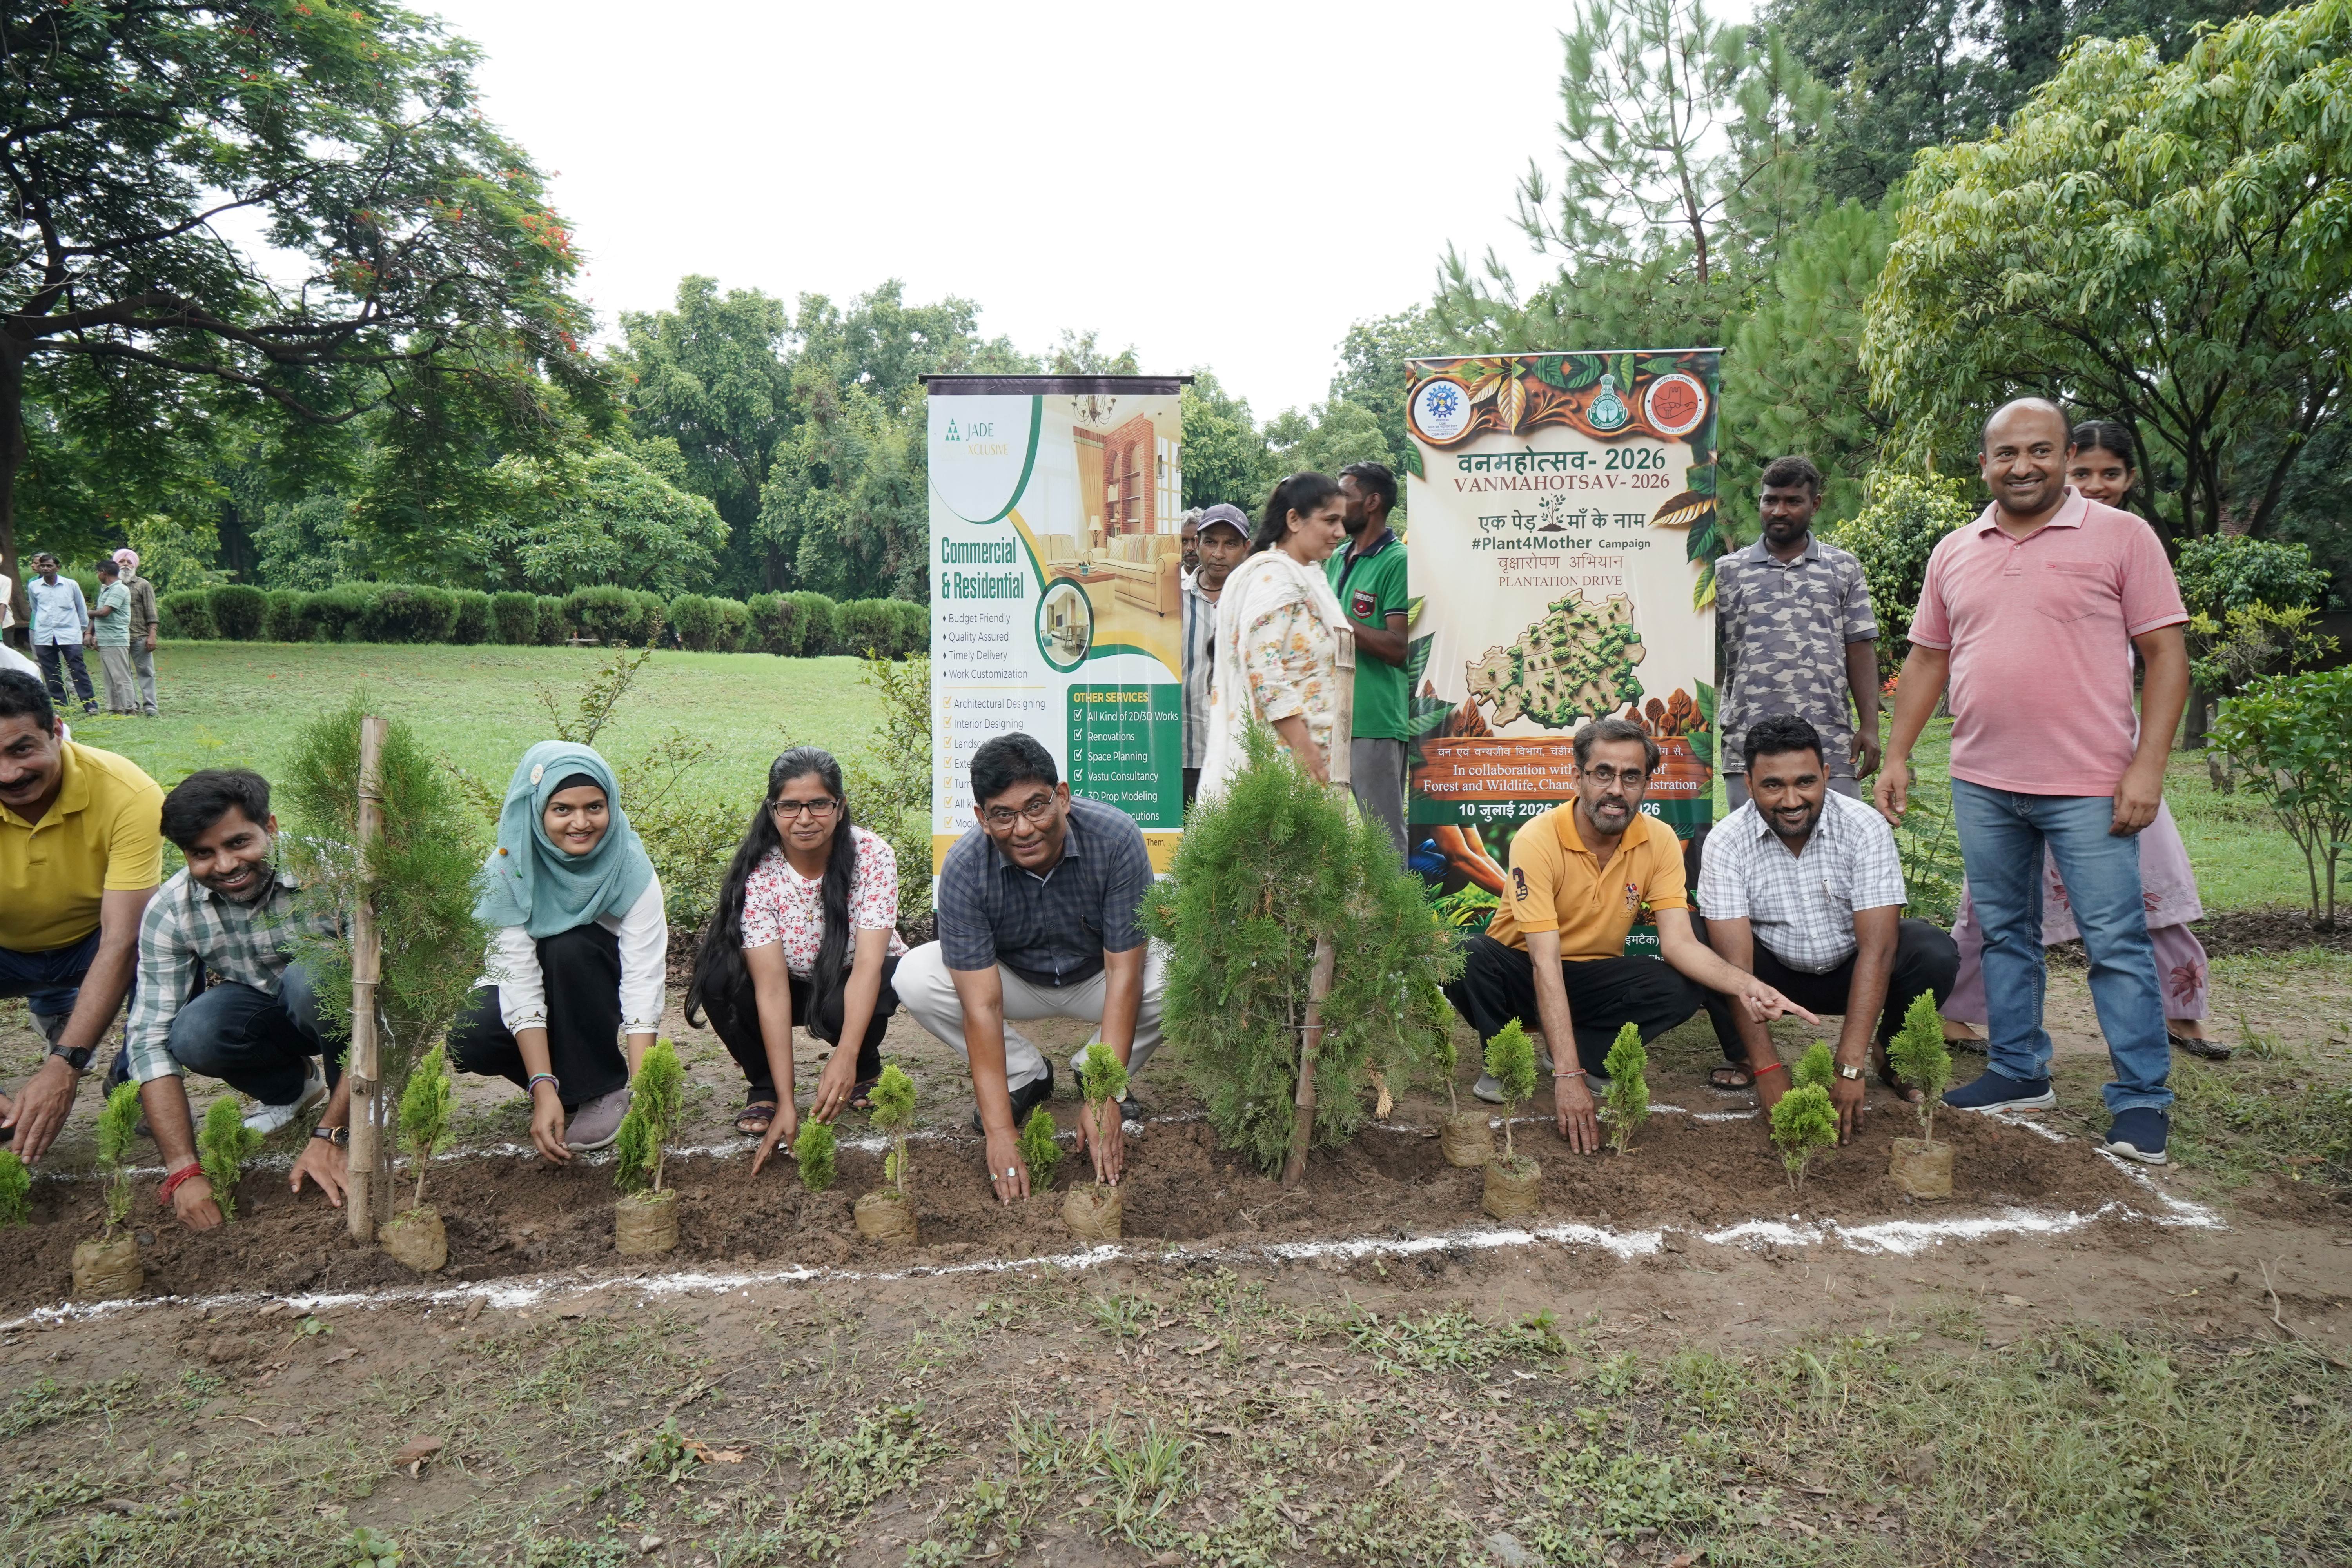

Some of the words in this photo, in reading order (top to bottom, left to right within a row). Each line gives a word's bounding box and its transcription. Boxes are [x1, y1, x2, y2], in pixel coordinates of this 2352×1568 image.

[1647, 410, 1671, 432] CHANDIGARH
[1671, 408, 1702, 433] ADMINISTRATION
[966, 423, 994, 441] JADE
[968, 444, 1009, 455] XCLUSIVE
[1604, 448, 1666, 470] 2026
[1453, 475, 1626, 493] VANMAHOTSAV-
[1631, 474, 1670, 489] 2026
[1478, 515, 1507, 533] एक
[1511, 510, 1537, 533] पेड़
[1566, 508, 1589, 529] माँ
[1591, 508, 1608, 529] के
[1613, 513, 1646, 529] नाम
[1472, 536, 1592, 550] #Plant4Mother
[1599, 539, 1651, 550] Campaign
[942, 537, 1016, 564] Commercial
[1497, 552, 1561, 574] वृक्षारोपण
[1569, 553, 1624, 570] अभियान
[942, 572, 950, 599] &
[954, 572, 1024, 599] Residential
[1499, 575, 1579, 587] PLANTATION
[1583, 575, 1622, 586] DRIVE
[1354, 592, 1374, 603] FRIENDS
[949, 613, 977, 625] Budget
[979, 613, 1011, 625] Friendly
[949, 632, 976, 644] Quality
[978, 632, 1009, 641] Assured
[949, 650, 975, 662] Timely
[977, 650, 1007, 662] Delivery
[949, 669, 969, 679] Work
[971, 669, 1028, 679] Customization
[1073, 692, 1104, 703] OTHER
[1106, 692, 1149, 702] SERVICES
[954, 699, 1004, 709] Architectural
[1007, 699, 1045, 711] Designing
[1087, 711, 1098, 721] All
[1099, 711, 1117, 721] Kind
[1119, 711, 1127, 721] of
[1128, 711, 1153, 722] 2D/3D
[1154, 711, 1178, 721] Works
[955, 719, 983, 728] Interior
[985, 719, 1024, 730] Designing
[1088, 731, 1135, 742] Renovations
[1088, 752, 1111, 763] Space
[1113, 751, 1148, 763] Planning
[1437, 748, 1452, 757] वन
[1456, 746, 1470, 758] एवं
[1474, 746, 1511, 757] वन्यजीव
[1515, 745, 1545, 757] विभाग,
[1673, 744, 1684, 757] से,
[1453, 764, 1465, 776] In
[1468, 763, 1546, 775] collaboration
[1088, 771, 1109, 781] Vastu
[1111, 771, 1159, 783] Consultancy
[1423, 779, 1459, 791] Forest
[1462, 779, 1483, 791] and
[1486, 779, 1537, 792] Wildlife,
[1647, 779, 1697, 790] istration
[1088, 791, 1099, 800] 3D
[1101, 791, 1119, 803] Prop
[1121, 789, 1158, 803] Modeling
[955, 799, 965, 808] All
[1459, 803, 1475, 816] 10
[1479, 800, 1516, 822] जुलाई
[1519, 803, 1553, 816] 2026
[1146, 838, 1166, 847] Them,
